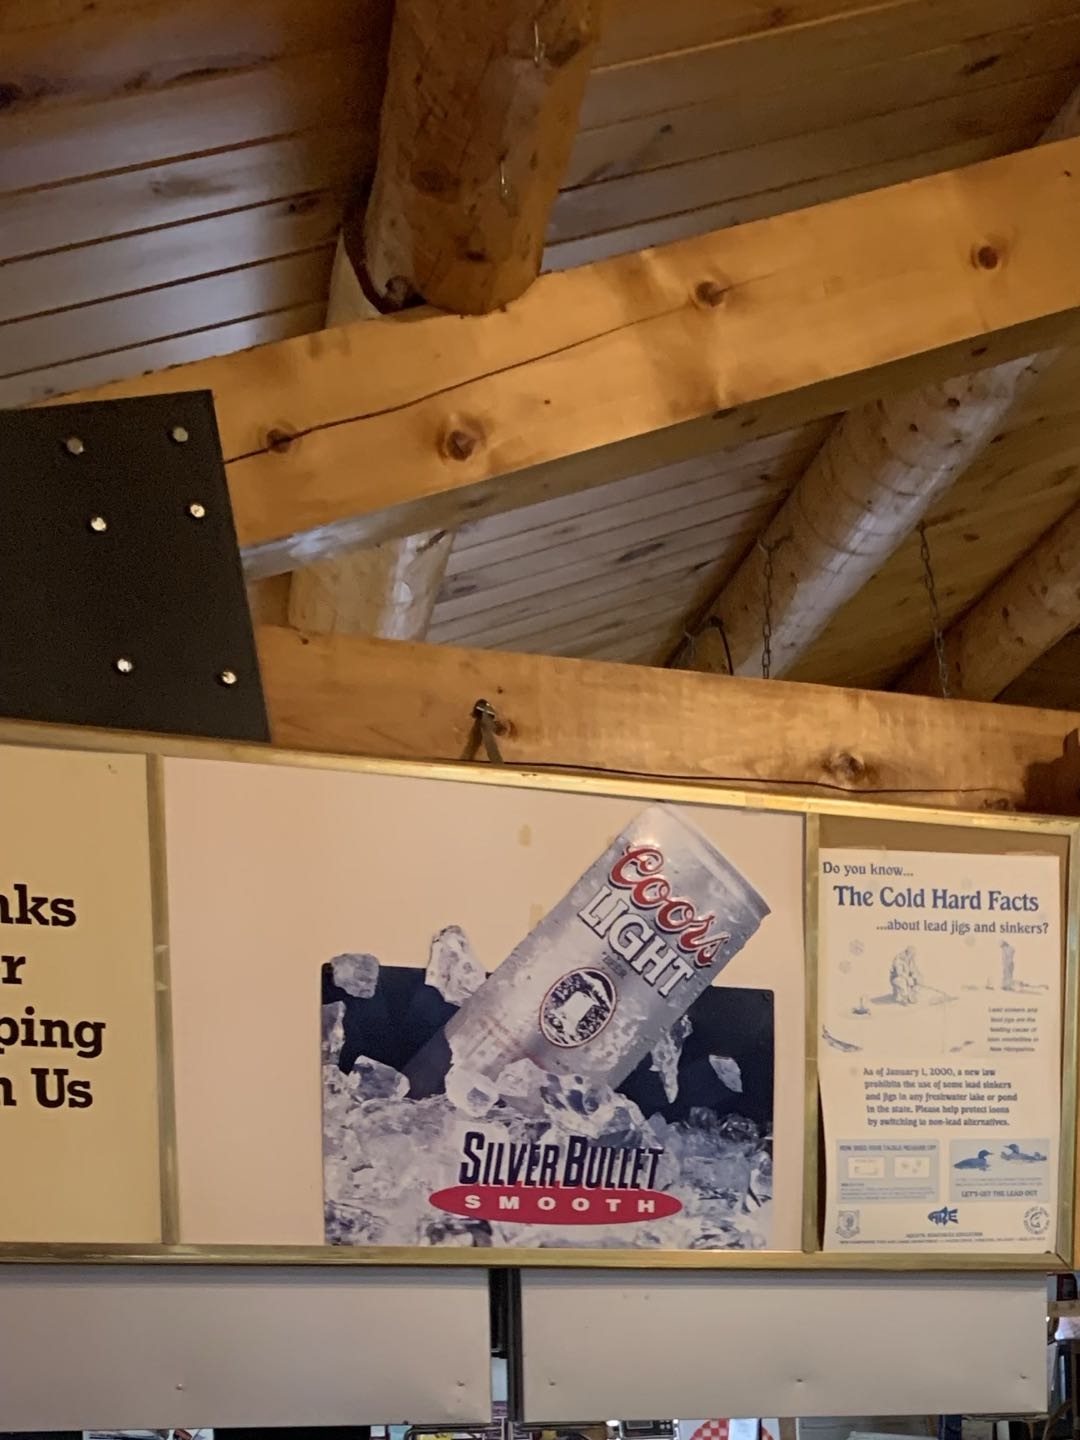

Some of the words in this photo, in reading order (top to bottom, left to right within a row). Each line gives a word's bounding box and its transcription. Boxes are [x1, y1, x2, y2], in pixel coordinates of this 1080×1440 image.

[823, 861, 840, 874] Do
[844, 864, 866, 877] you
[870, 863, 914, 877] know...
[608, 845, 732, 968] Coors
[833, 885, 873, 906] The
[880, 887, 925, 908] Cold
[932, 889, 982, 910] Hard
[988, 891, 1039, 912] Facts
[924, 920, 947, 932] lead
[950, 920, 970, 935] jigs
[974, 921, 996, 933] and
[1000, 921, 1049, 934] sinkers?
[577, 886, 694, 998] LIGHT
[31, 1068, 93, 1109] Us
[464, 1195, 656, 1214] SMOOTH
